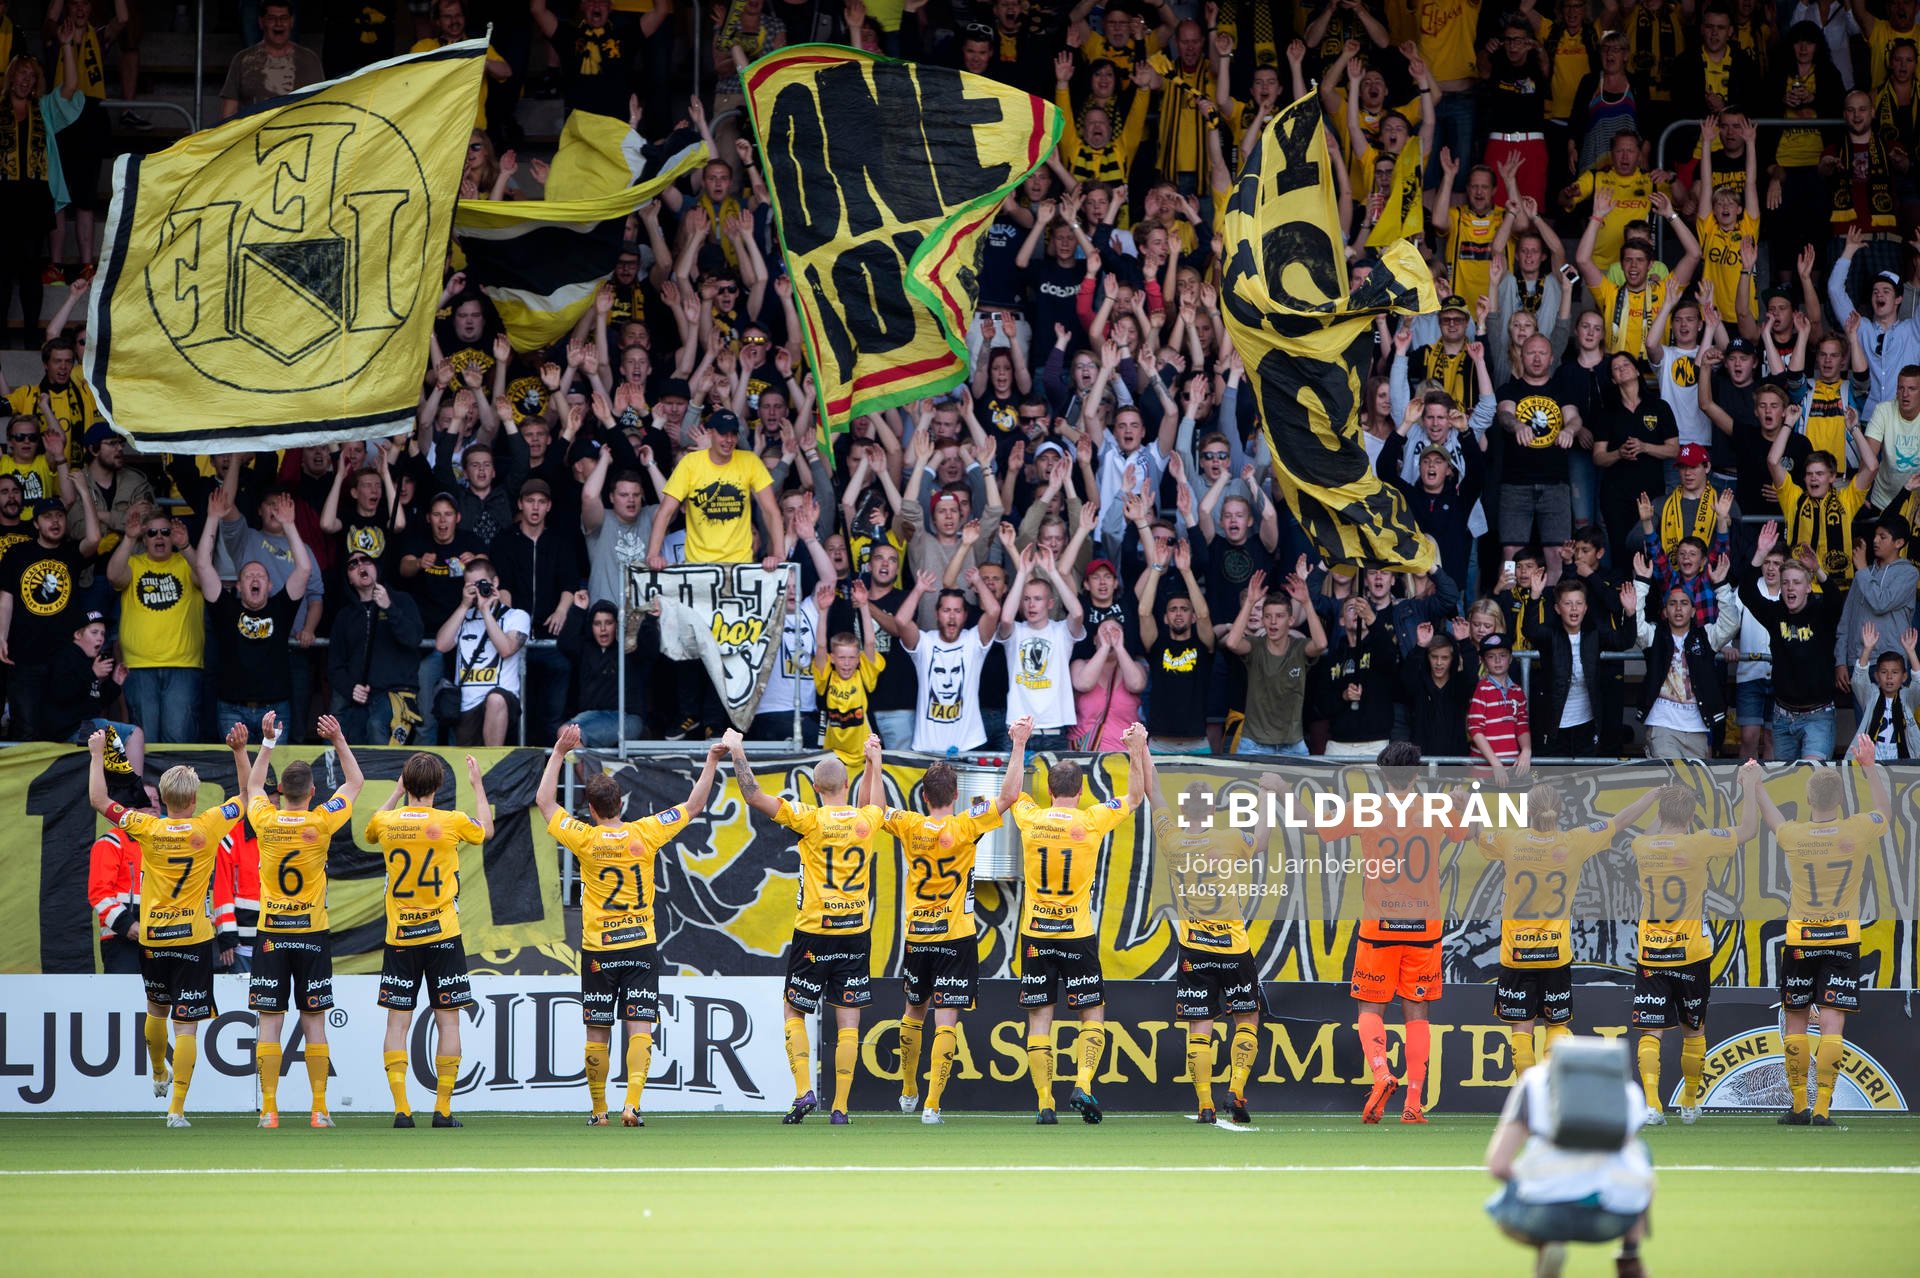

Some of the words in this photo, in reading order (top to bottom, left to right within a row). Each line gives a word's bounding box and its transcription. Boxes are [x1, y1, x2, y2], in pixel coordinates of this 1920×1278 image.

[767, 60, 1011, 255] ONE
[143, 591, 178, 605] POLICE
[931, 700, 962, 720] TACO
[387, 824, 421, 832] Swedbank
[167, 857, 194, 899] 7
[278, 850, 303, 897] 6
[389, 848, 443, 898] 24
[822, 846, 865, 892] 12
[912, 856, 962, 900] 25
[1037, 847, 1074, 895] 11
[1377, 835, 1430, 884] 30
[598, 864, 648, 911] 21
[1513, 870, 1567, 919] 23
[1644, 875, 1687, 924] 19
[1803, 859, 1853, 907] 17
[1515, 933, 1548, 942] BORÅS
[790, 973, 821, 992] jetshop
[934, 975, 968, 988] jetshop
[1066, 974, 1099, 988] jetshop
[1353, 971, 1386, 982] jetshop
